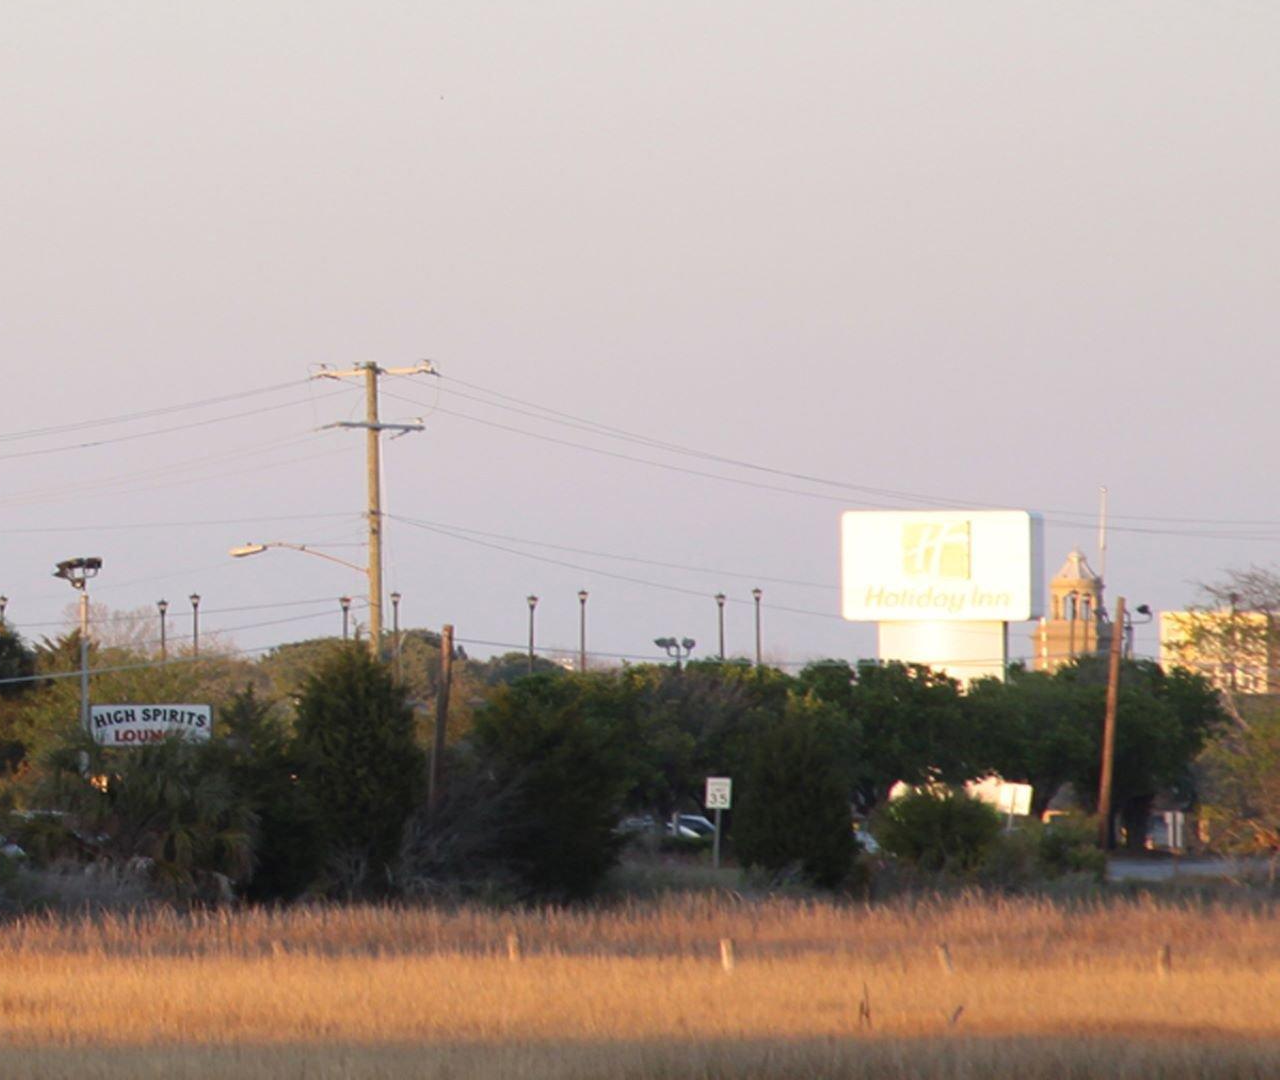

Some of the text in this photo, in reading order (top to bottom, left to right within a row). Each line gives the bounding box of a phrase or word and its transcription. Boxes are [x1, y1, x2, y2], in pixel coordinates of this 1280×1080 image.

[865, 584, 1012, 612] Holiday Inn
[94, 708, 207, 728] HIGH SPIRITS
[709, 793, 728, 805] 35
